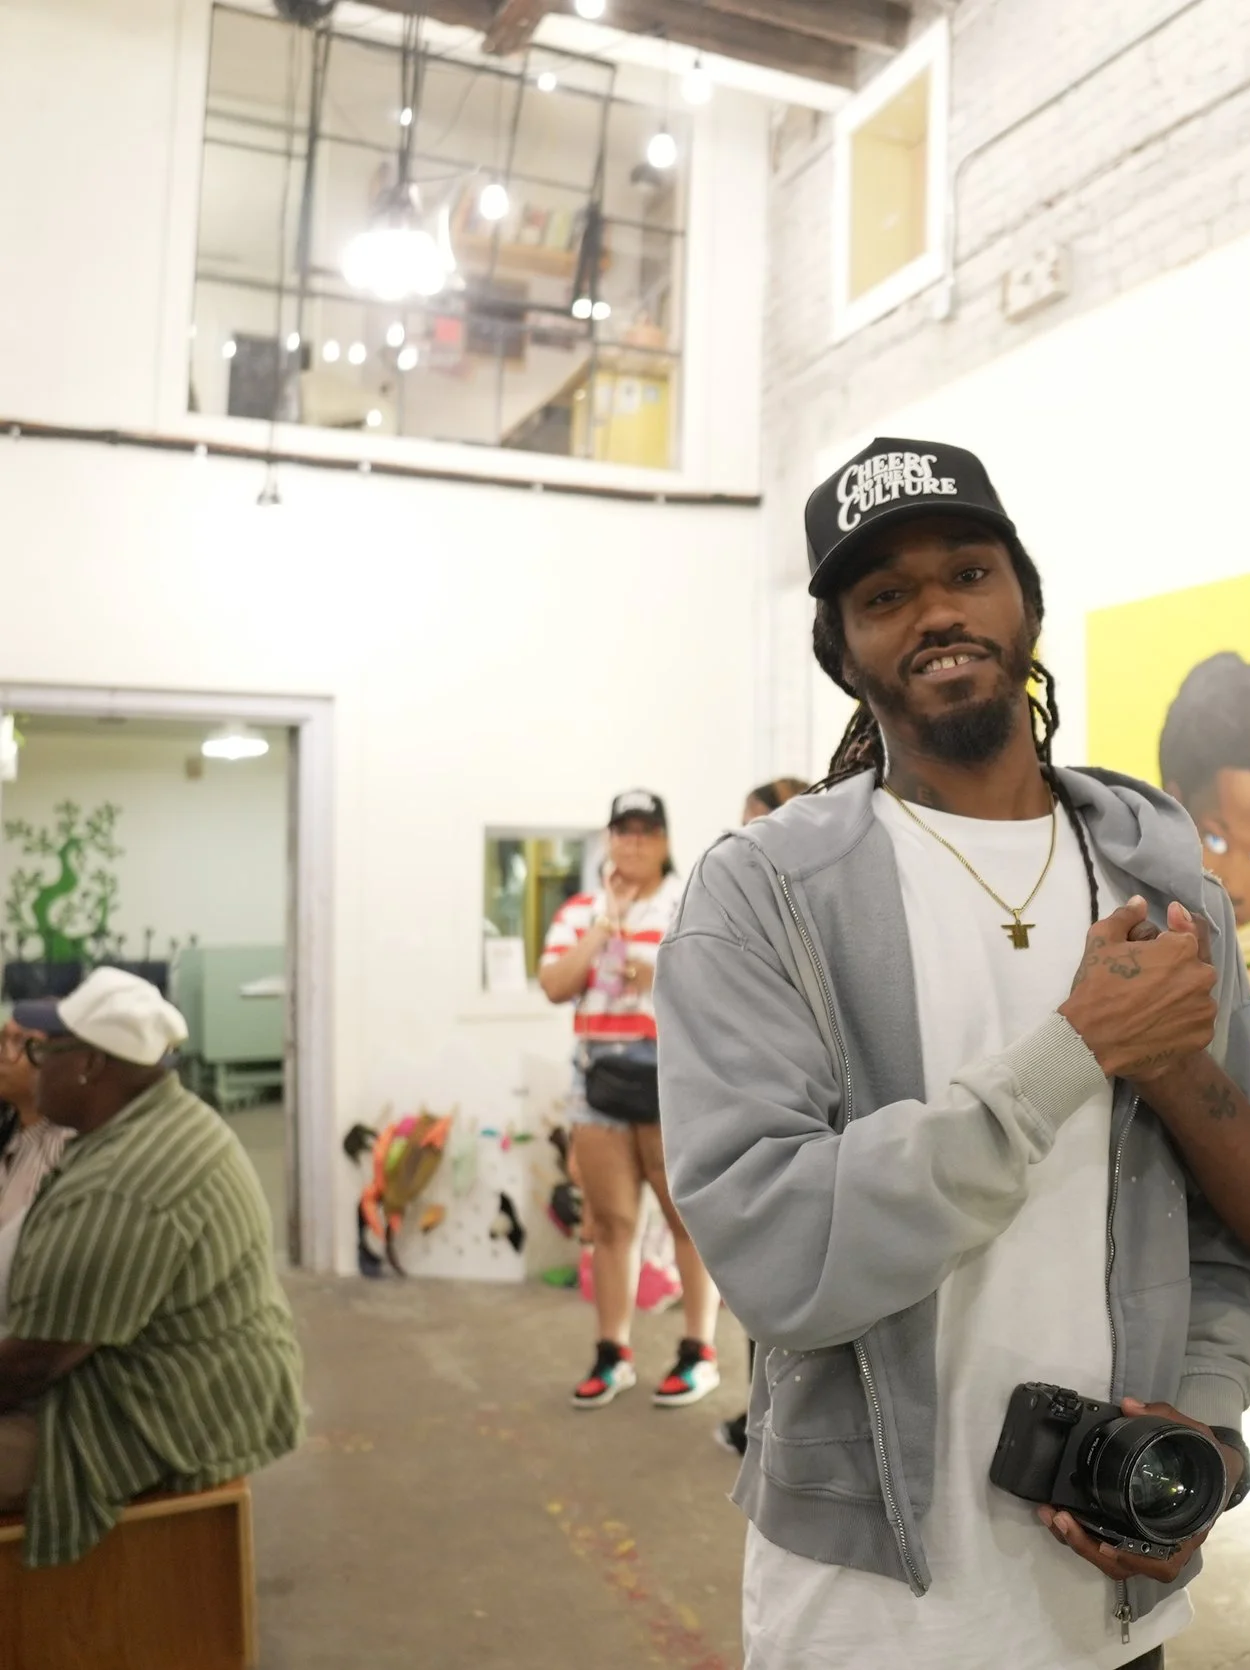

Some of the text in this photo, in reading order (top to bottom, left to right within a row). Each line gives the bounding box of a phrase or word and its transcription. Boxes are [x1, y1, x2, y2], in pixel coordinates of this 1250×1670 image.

[836, 452, 937, 504] CHEERS
[873, 469, 904, 485] THE
[837, 477, 958, 532] CULTURE
